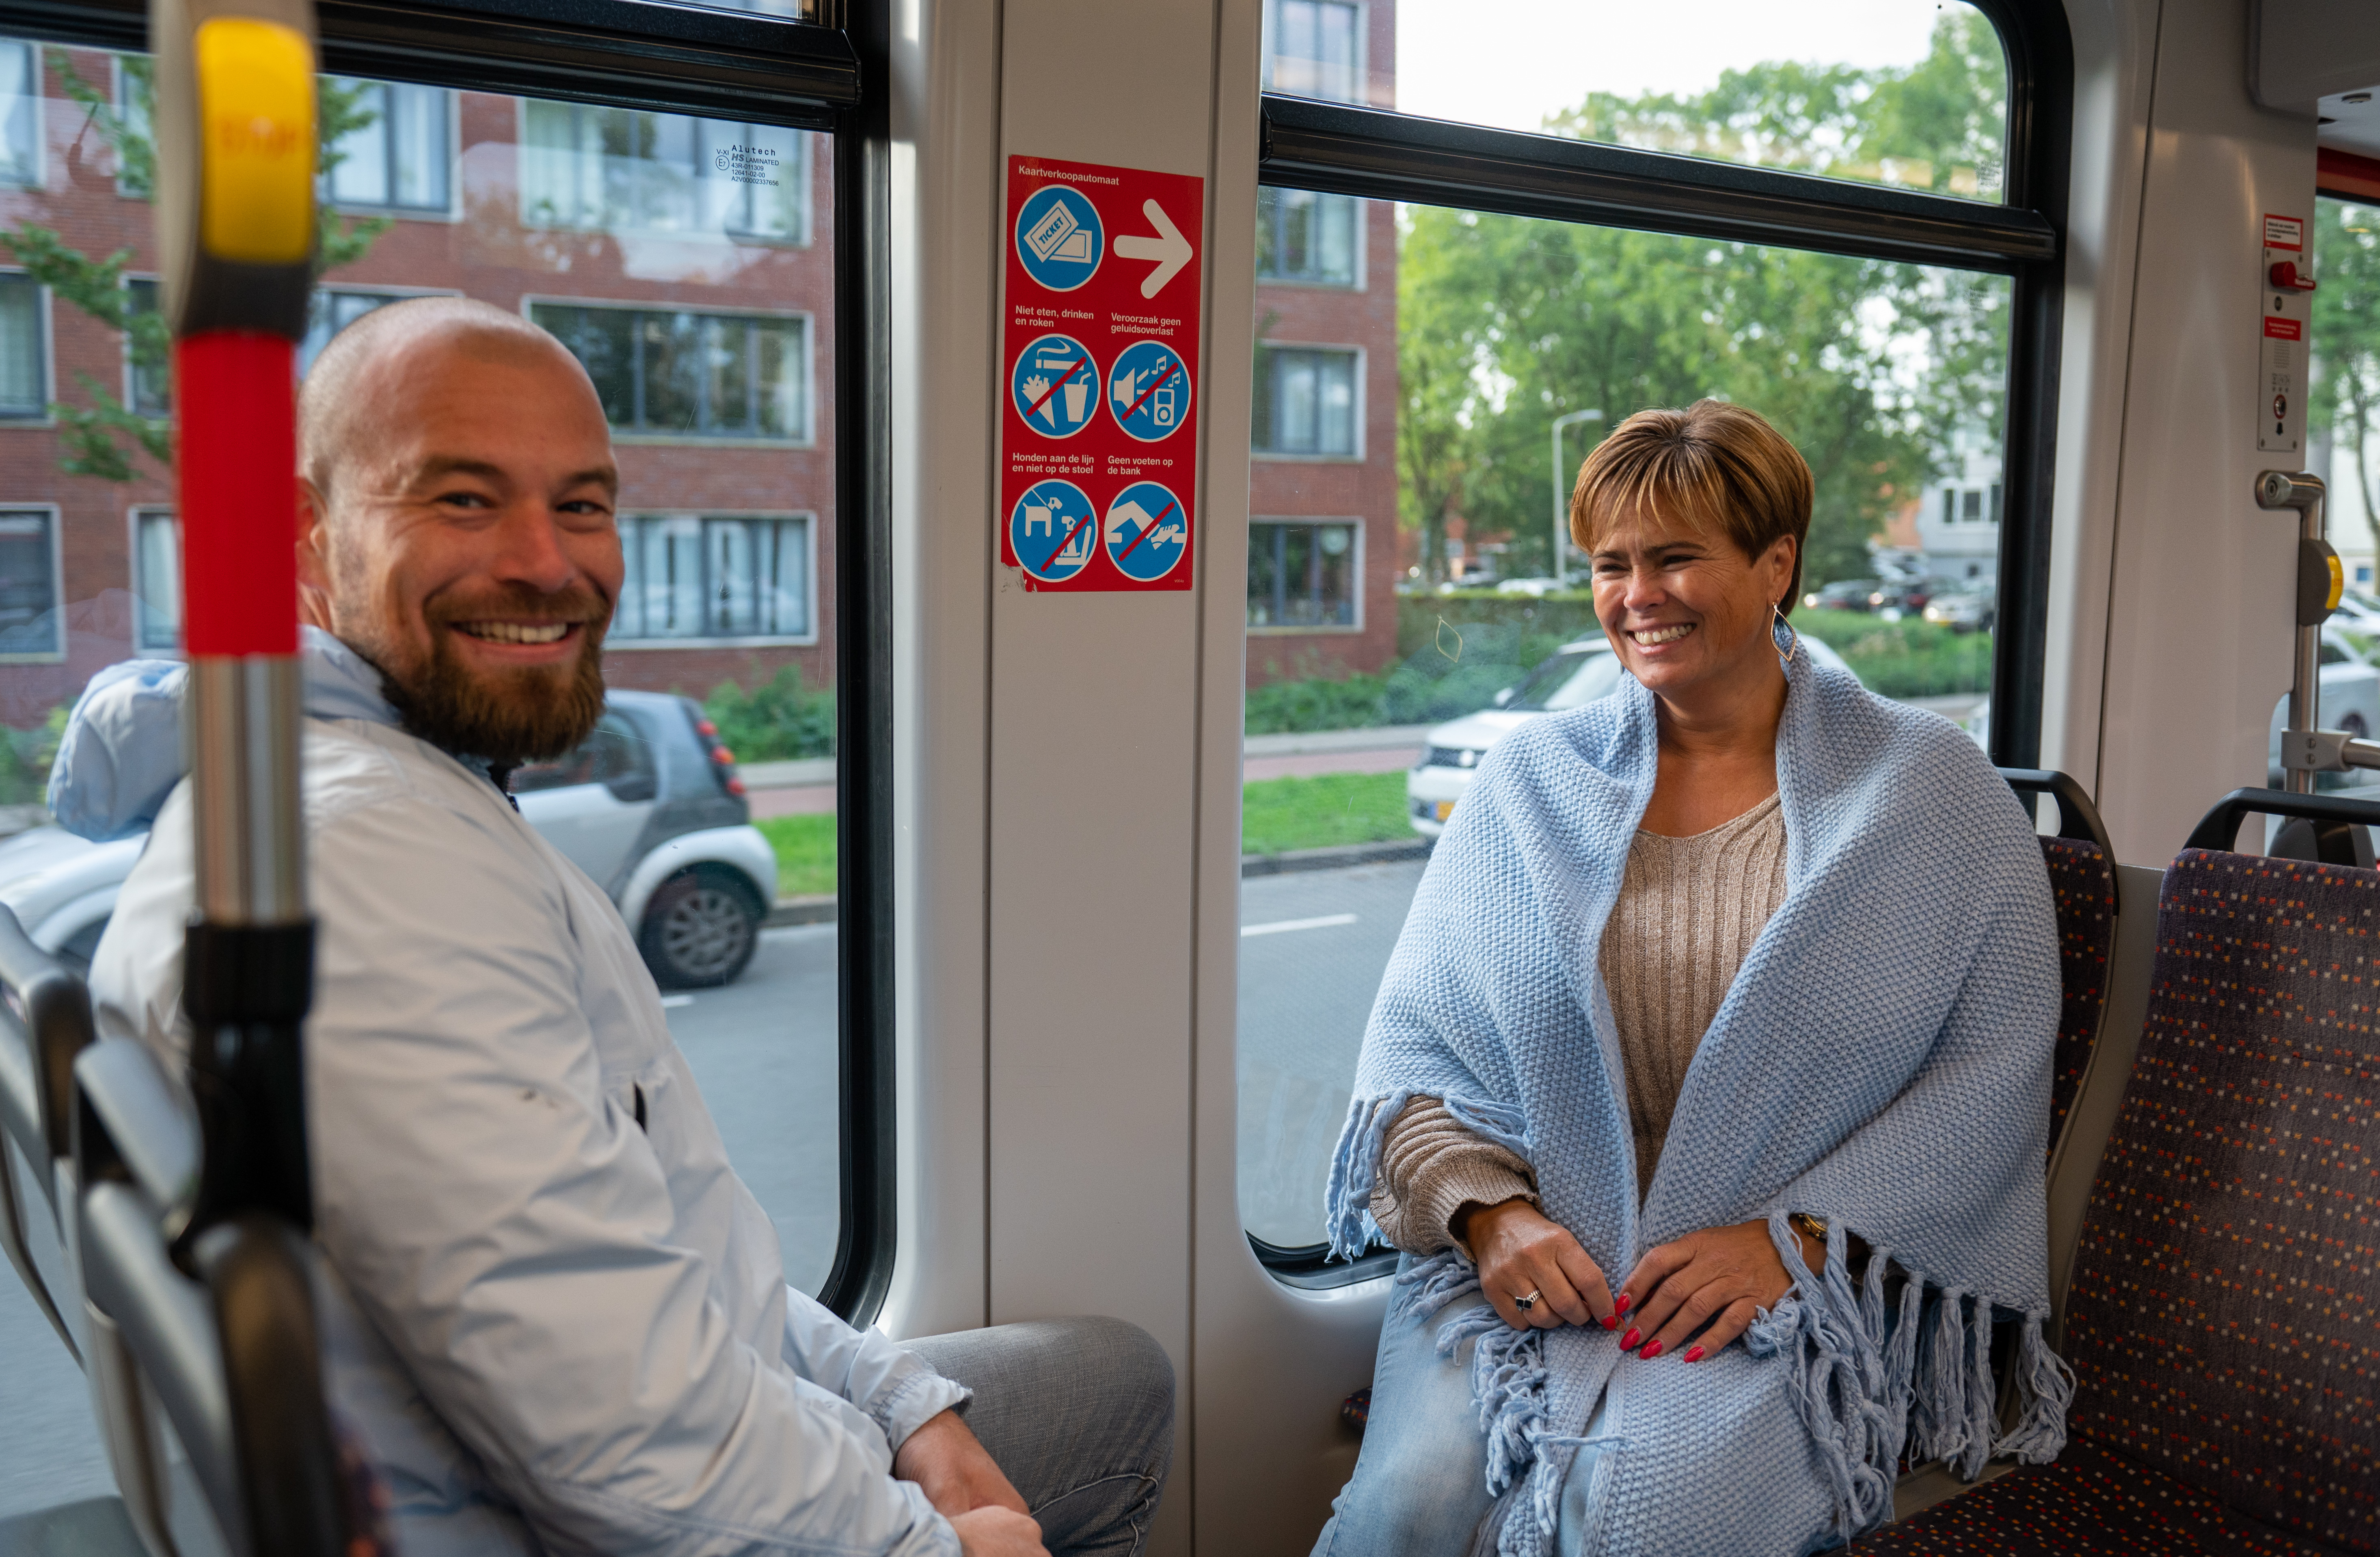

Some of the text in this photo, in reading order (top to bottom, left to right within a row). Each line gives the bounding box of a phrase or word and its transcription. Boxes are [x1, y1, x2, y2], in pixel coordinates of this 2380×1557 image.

[732, 145, 775, 156] Alutech
[732, 153, 779, 166] HS LAMINATED
[731, 162, 764, 171] 43R-011309
[732, 169, 765, 178] 12641-02-00
[1019, 165, 1119, 185] Kaartverkoopautomaat
[731, 176, 779, 186] A2V00002337656
[1038, 216, 1064, 244] TICKET
[1015, 305, 1094, 319] Niet eten, drinken
[1029, 318, 1054, 327] roken
[1111, 312, 1181, 327] Veroorzaak geen
[1111, 325, 1174, 335] geluidsoverlast
[1013, 452, 1047, 462] Honden
[1068, 454, 1079, 463] de
[1082, 454, 1094, 465] lijn
[1108, 455, 1130, 465] Geen
[1132, 457, 1160, 465] voeten
[1059, 465, 1070, 473] de
[1072, 466, 1093, 474] stoel
[1107, 466, 1140, 475] de bank
